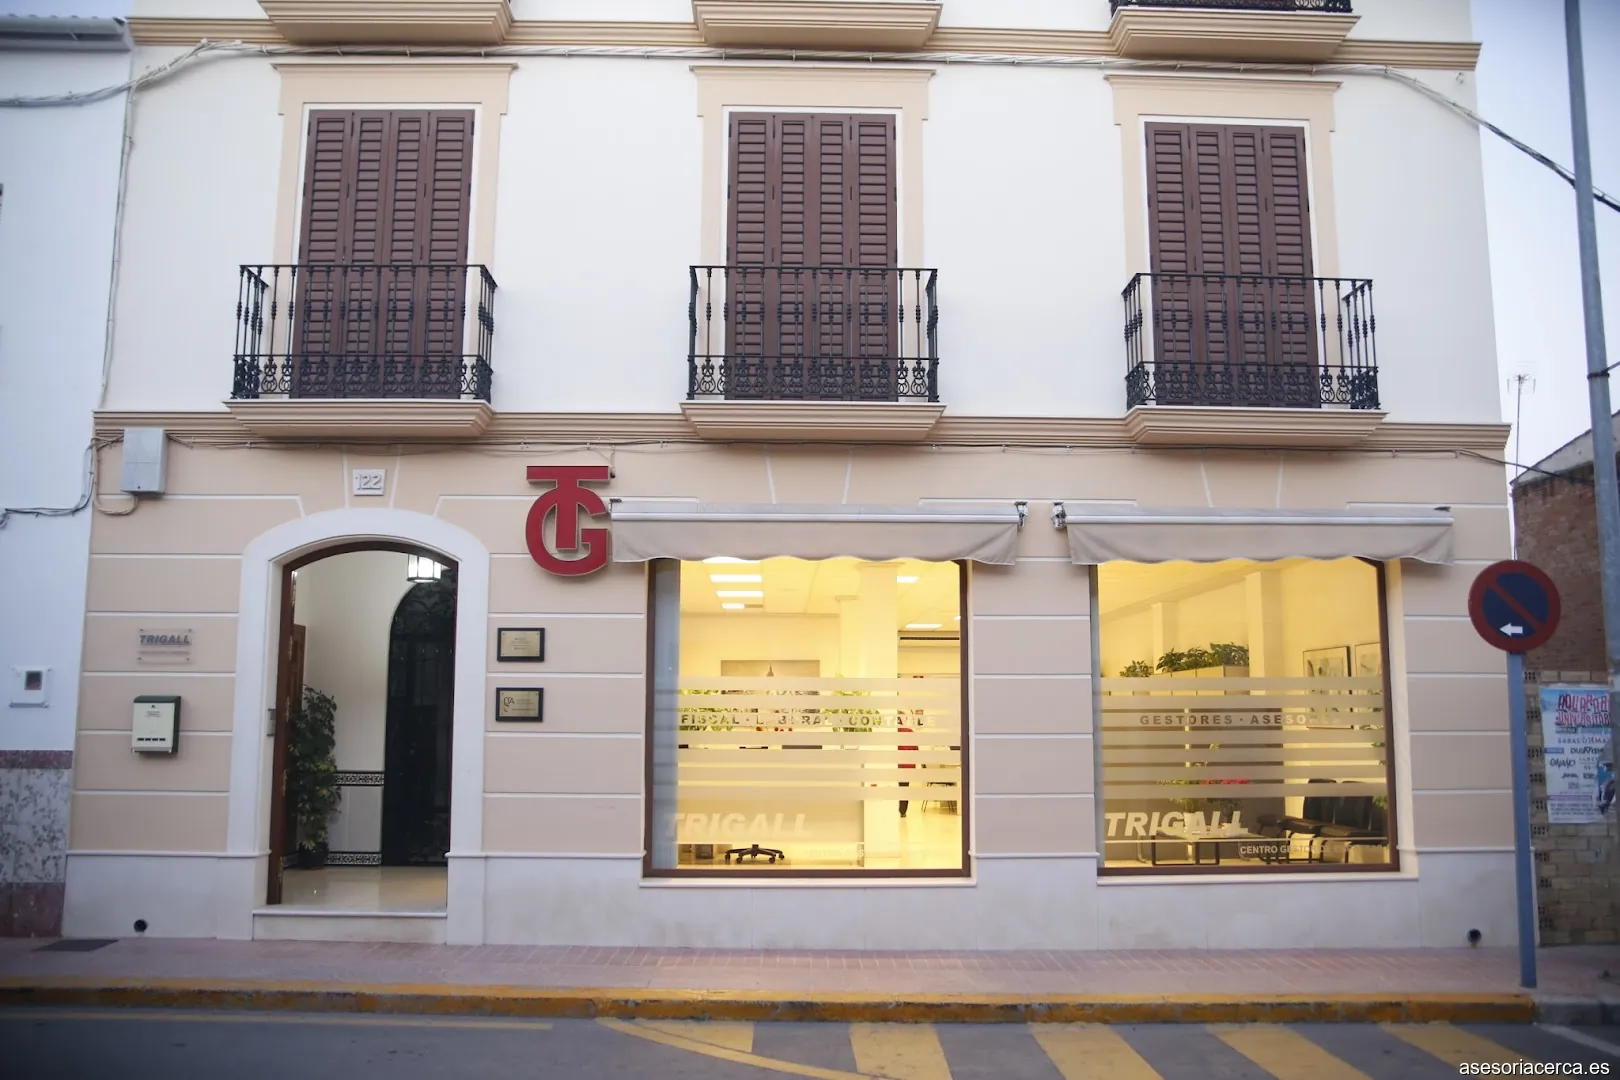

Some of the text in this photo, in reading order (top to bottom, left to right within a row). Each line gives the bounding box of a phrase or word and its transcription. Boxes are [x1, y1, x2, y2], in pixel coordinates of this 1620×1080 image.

[139, 634, 190, 645] TRIGALL
[1557, 693, 1611, 713] AQUAPAR
[681, 714, 935, 726] FISCAL LBRAL CONTALE
[1139, 715, 1233, 725] GESTORES
[665, 812, 812, 838] TRIGALL
[1104, 810, 1248, 837] TRIGALL
[1239, 845, 1278, 854] CENTRO
